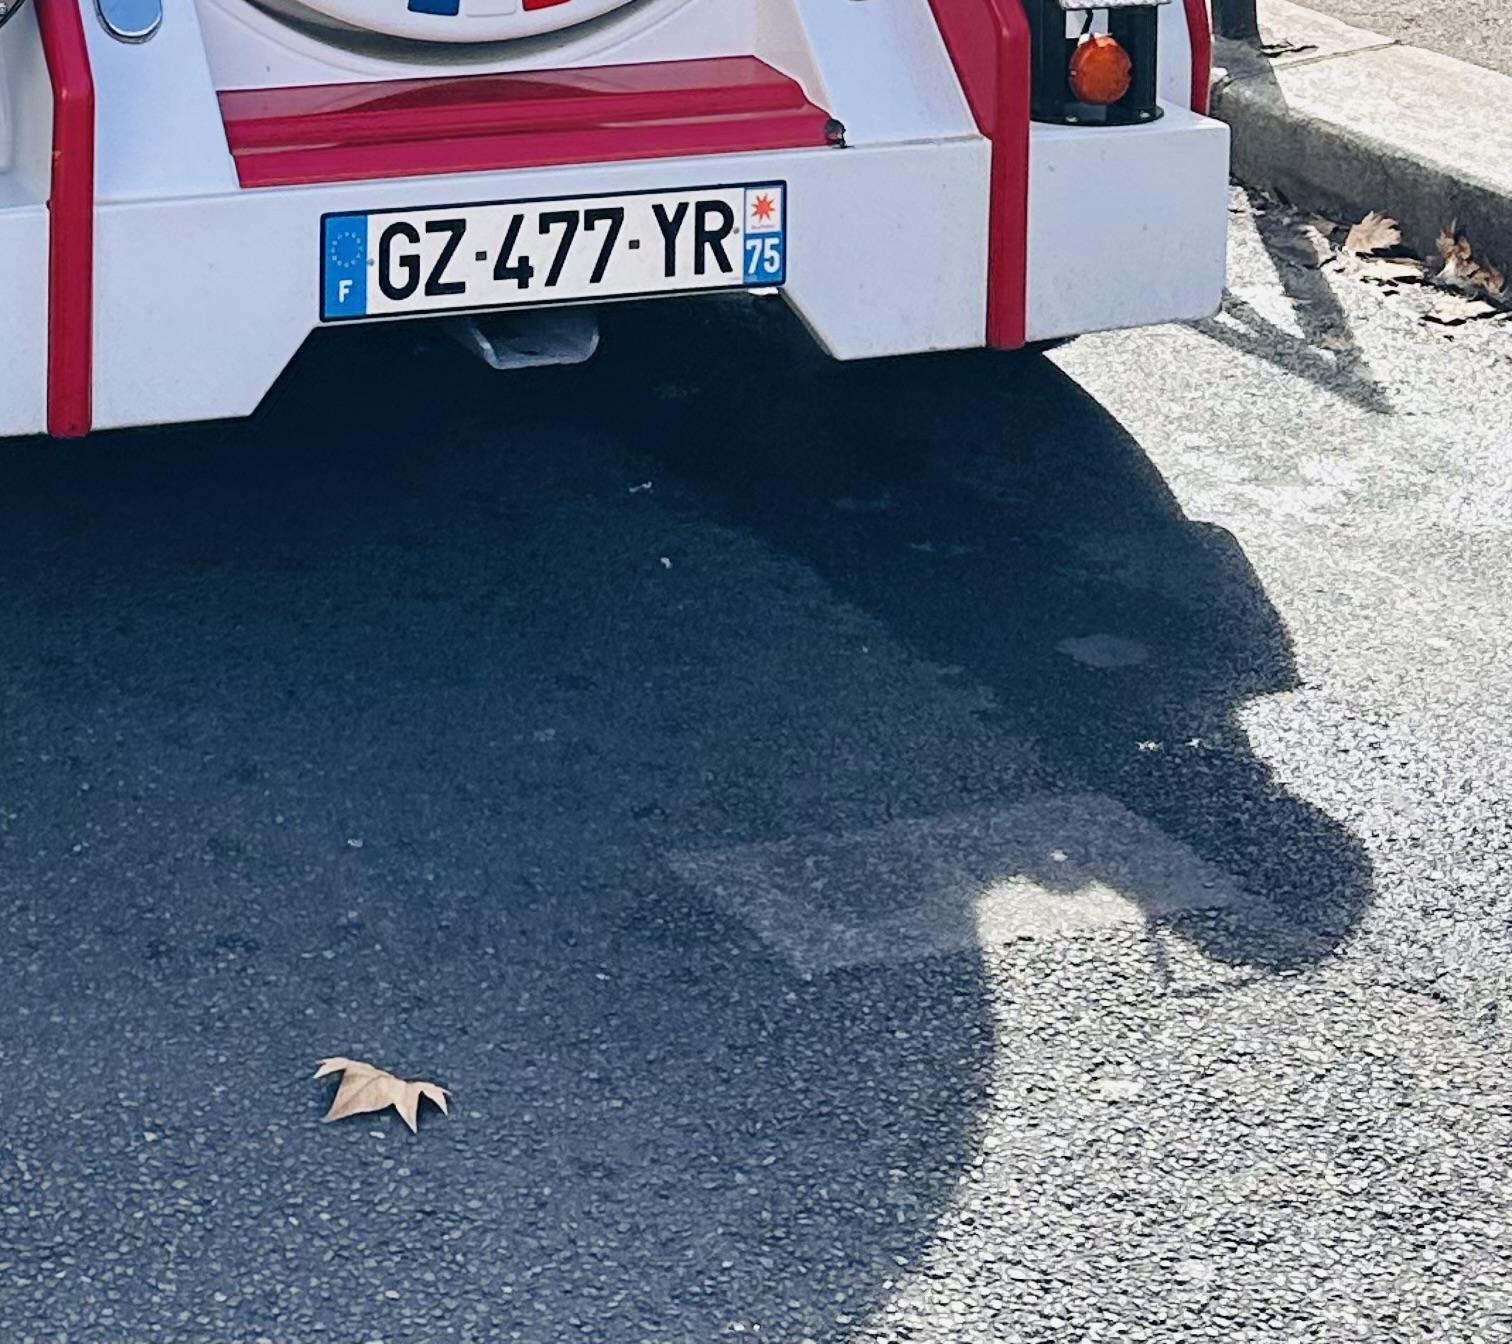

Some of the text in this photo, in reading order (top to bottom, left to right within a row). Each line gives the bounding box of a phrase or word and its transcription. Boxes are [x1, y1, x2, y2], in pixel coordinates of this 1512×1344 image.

[338, 199, 781, 304] F GZ-477-YR 75
